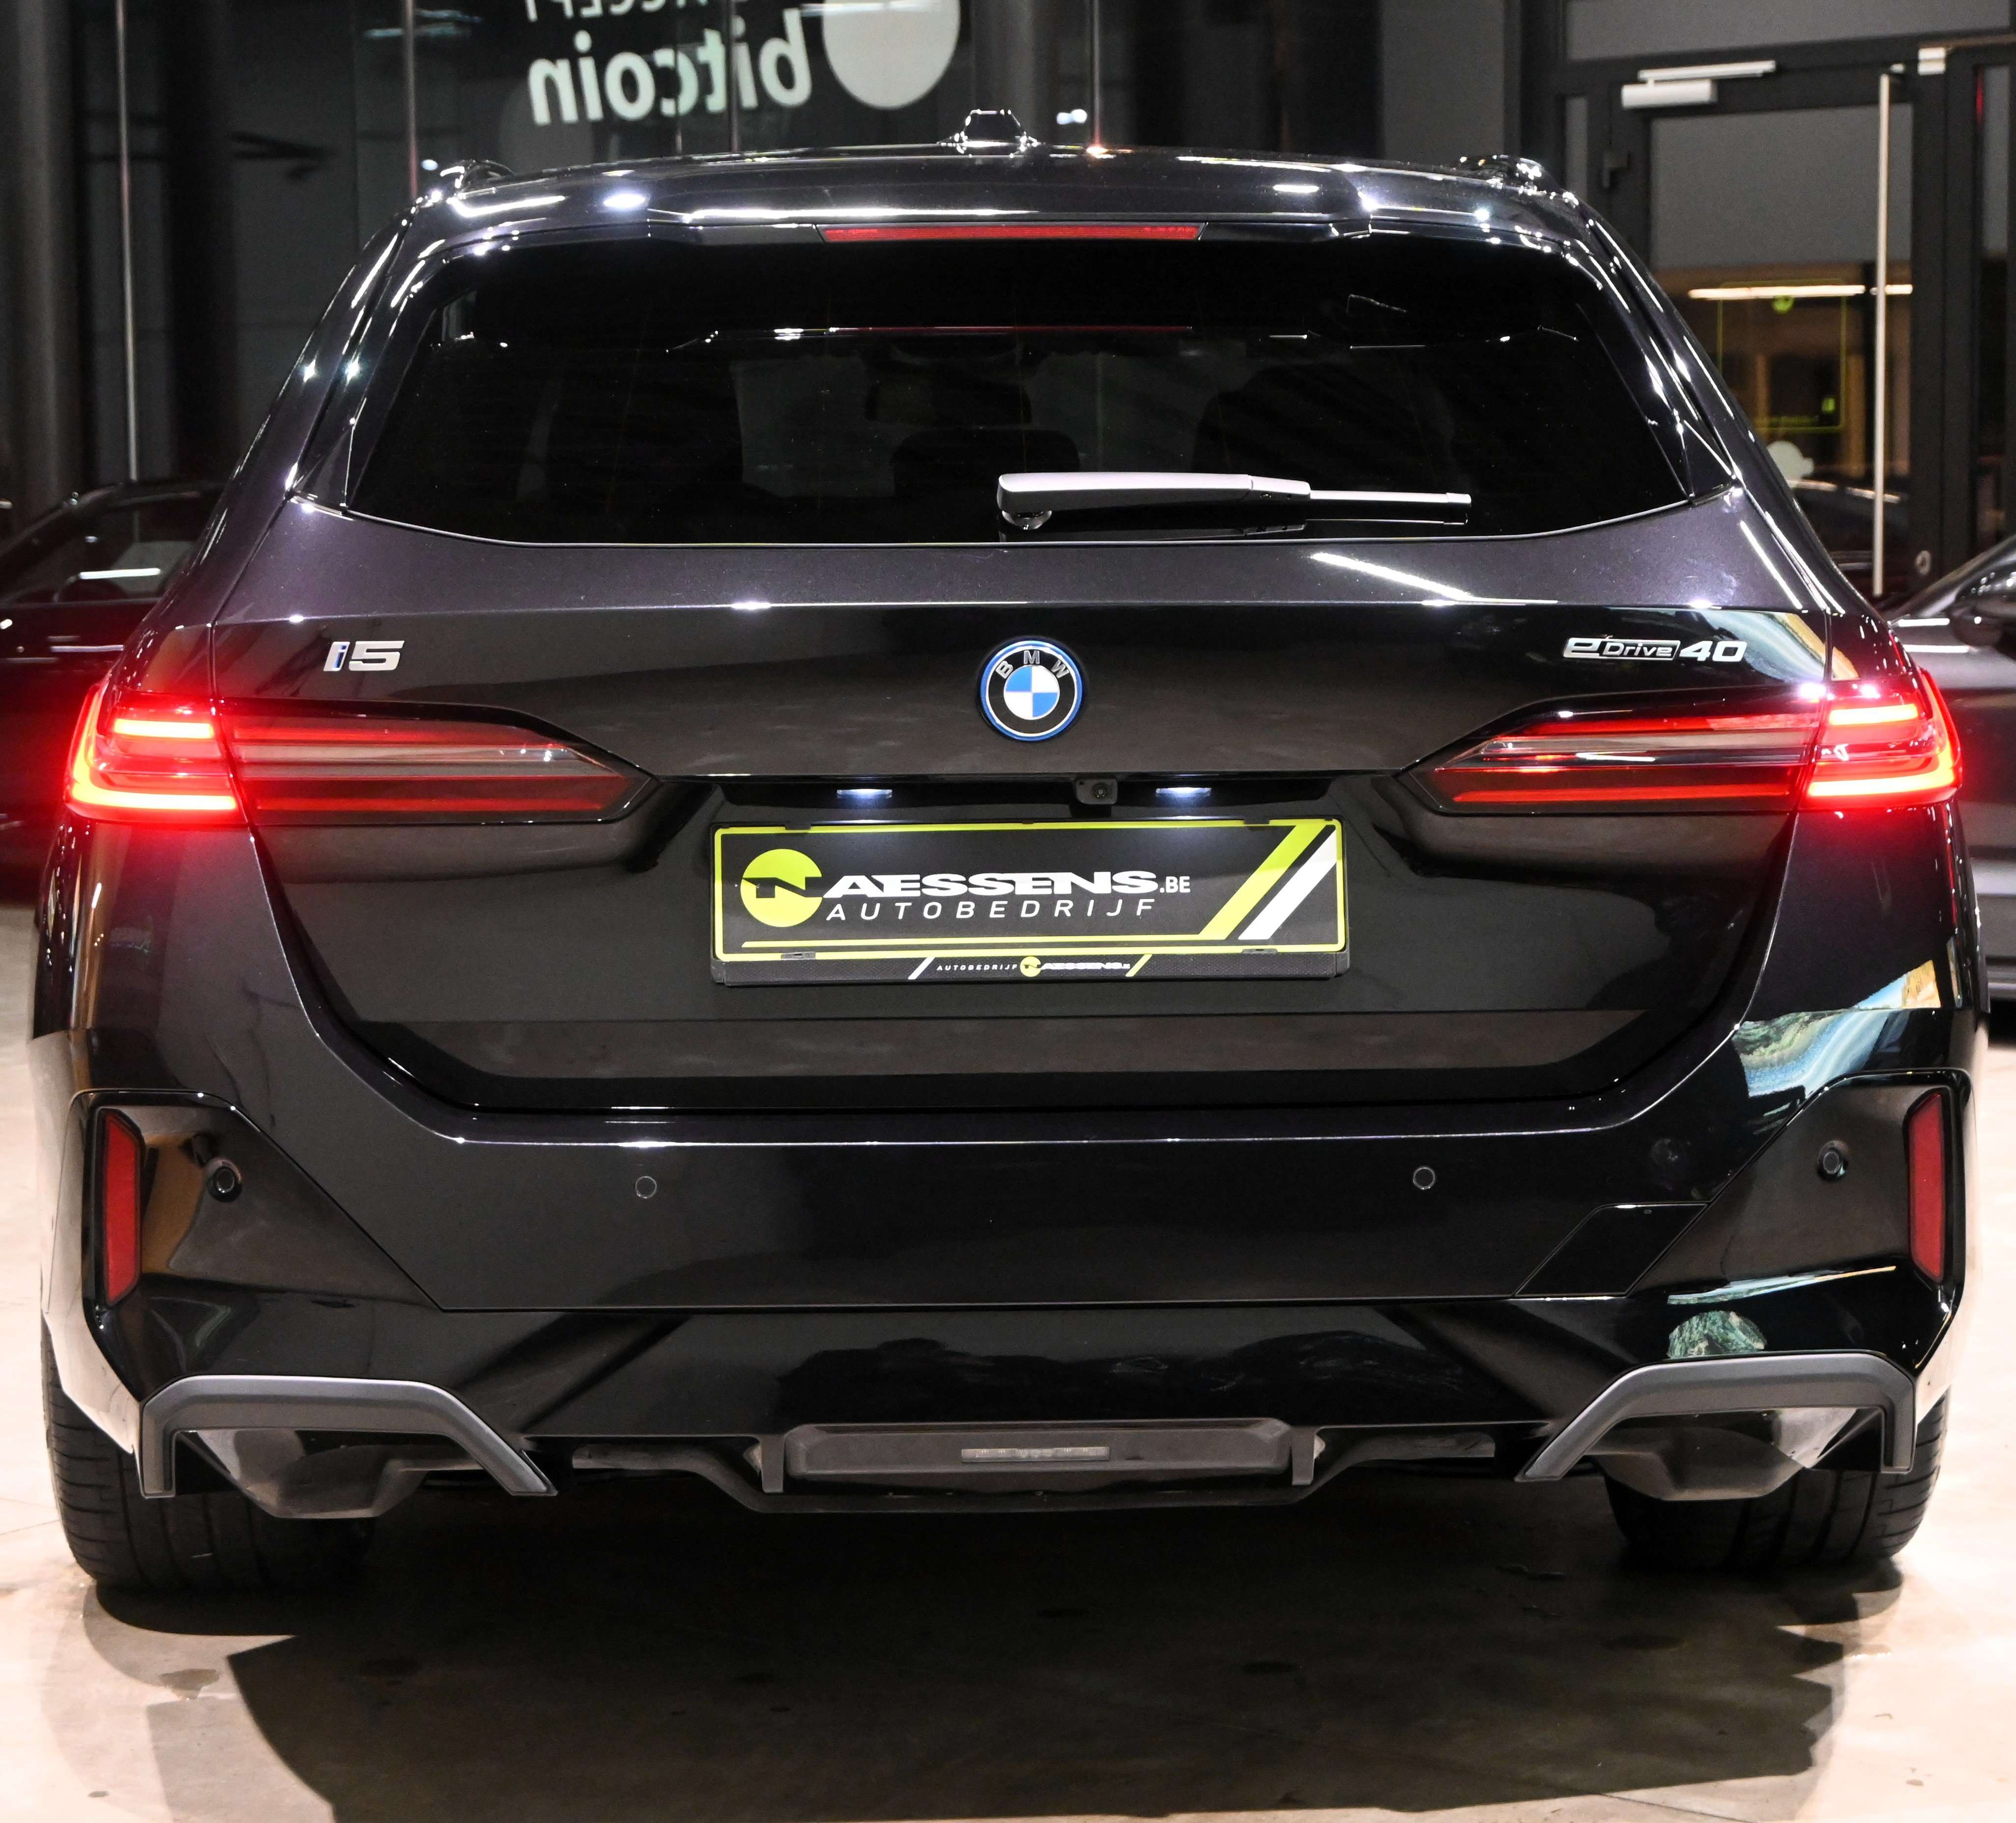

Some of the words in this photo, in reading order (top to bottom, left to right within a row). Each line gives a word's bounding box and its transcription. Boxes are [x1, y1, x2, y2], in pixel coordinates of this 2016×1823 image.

[324, 640, 405, 671] i5
[995, 650, 1069, 679] BMW
[826, 899, 1155, 921] AUTOBEDRIJF
